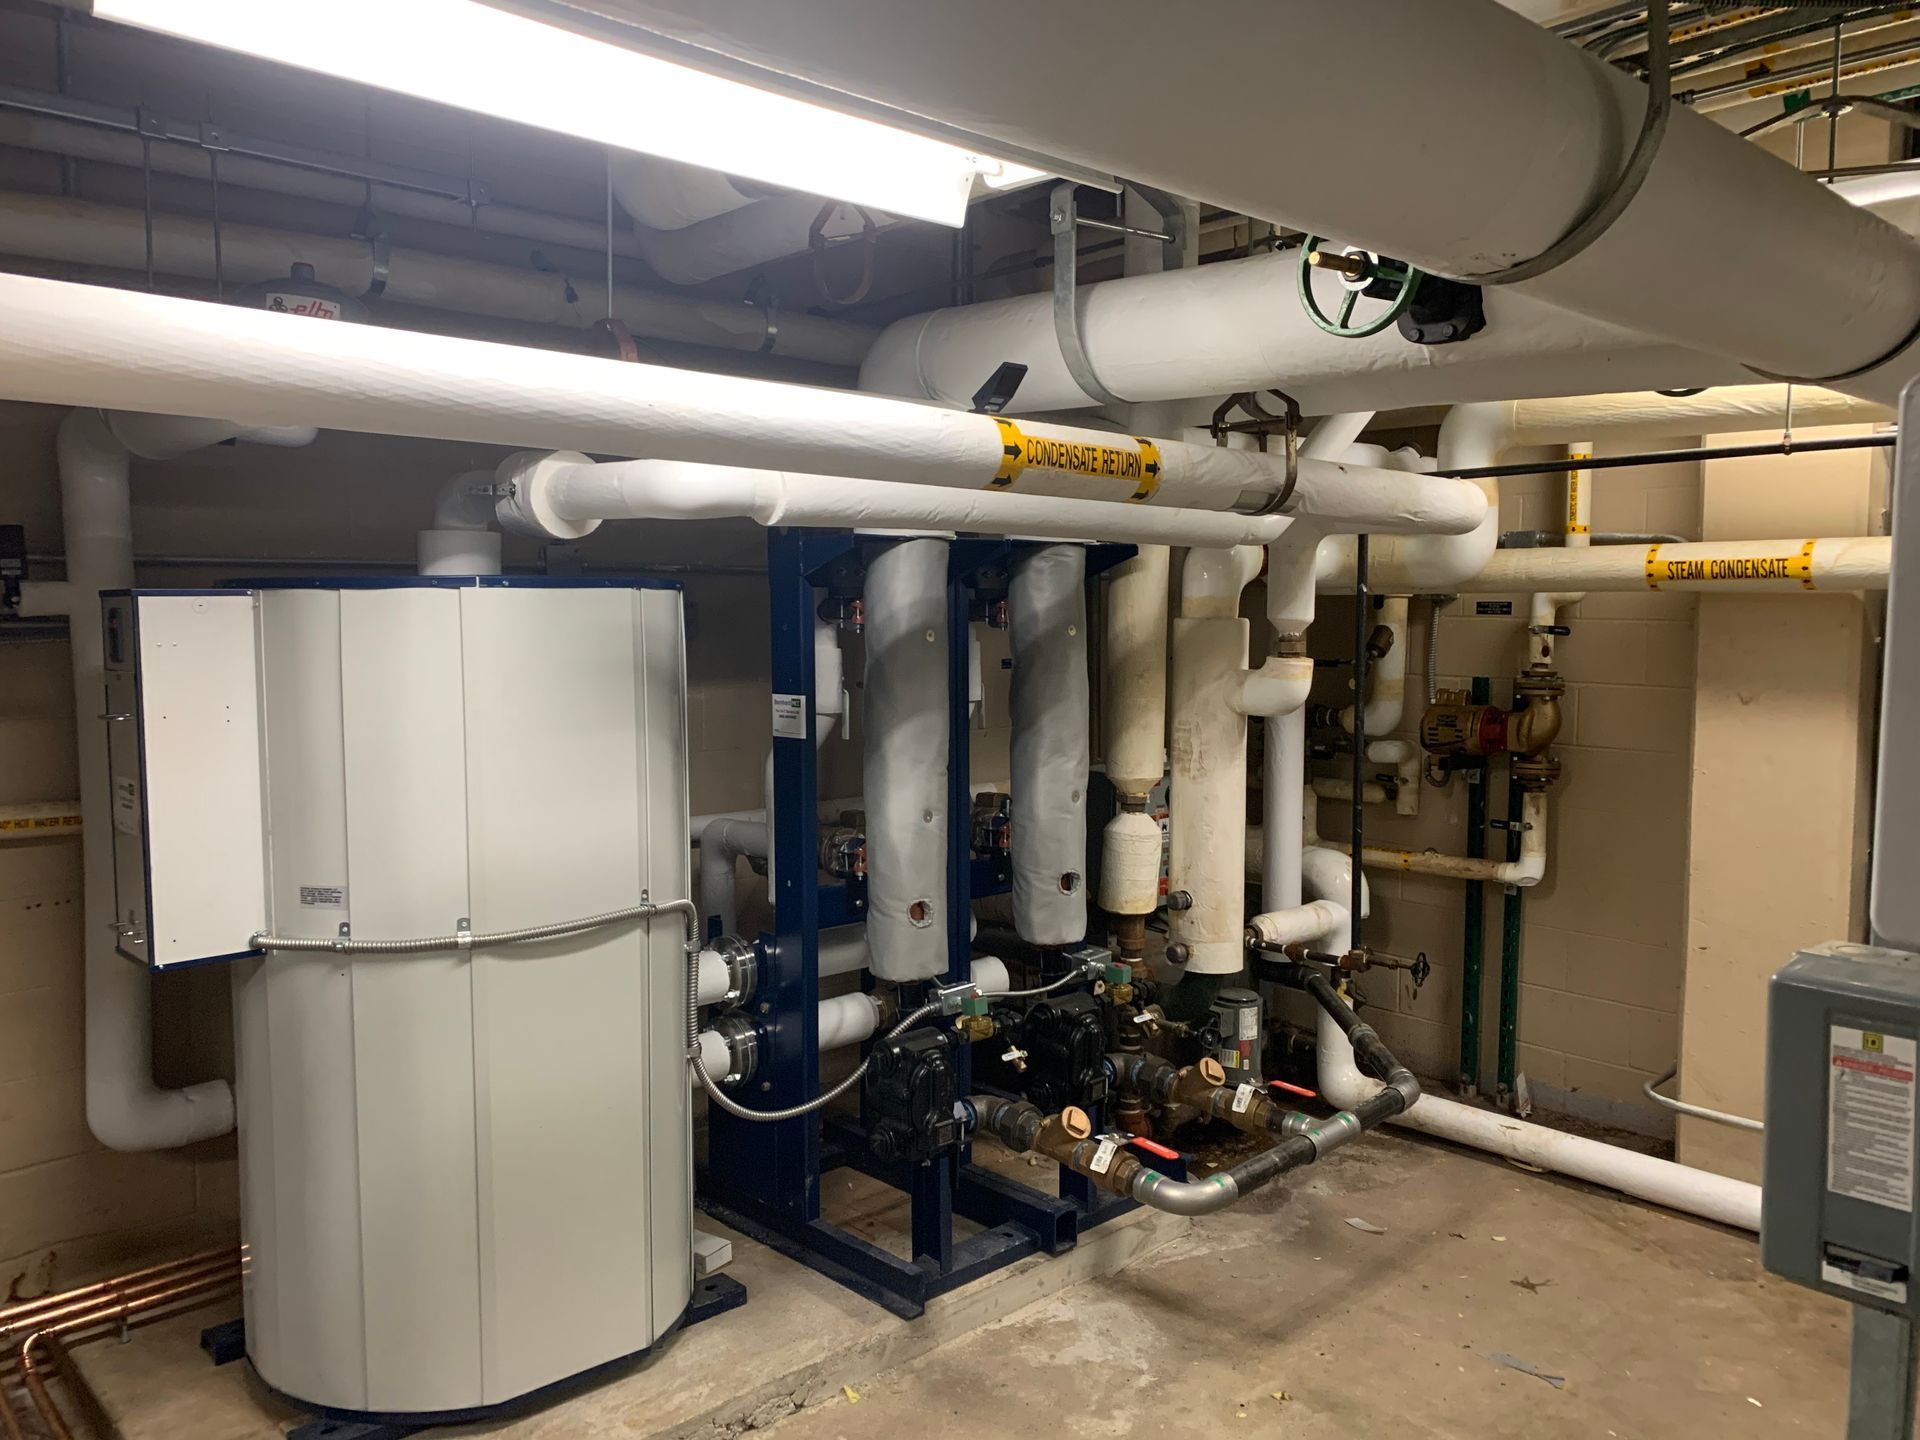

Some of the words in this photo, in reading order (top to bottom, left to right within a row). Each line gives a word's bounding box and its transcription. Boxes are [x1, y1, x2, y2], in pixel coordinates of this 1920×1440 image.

[1027, 439, 1098, 473] CONDENSATE
[1101, 449, 1142, 478] RETURN
[1667, 560, 1705, 580] STEAM
[1710, 558, 1789, 579] CONDENSATE
